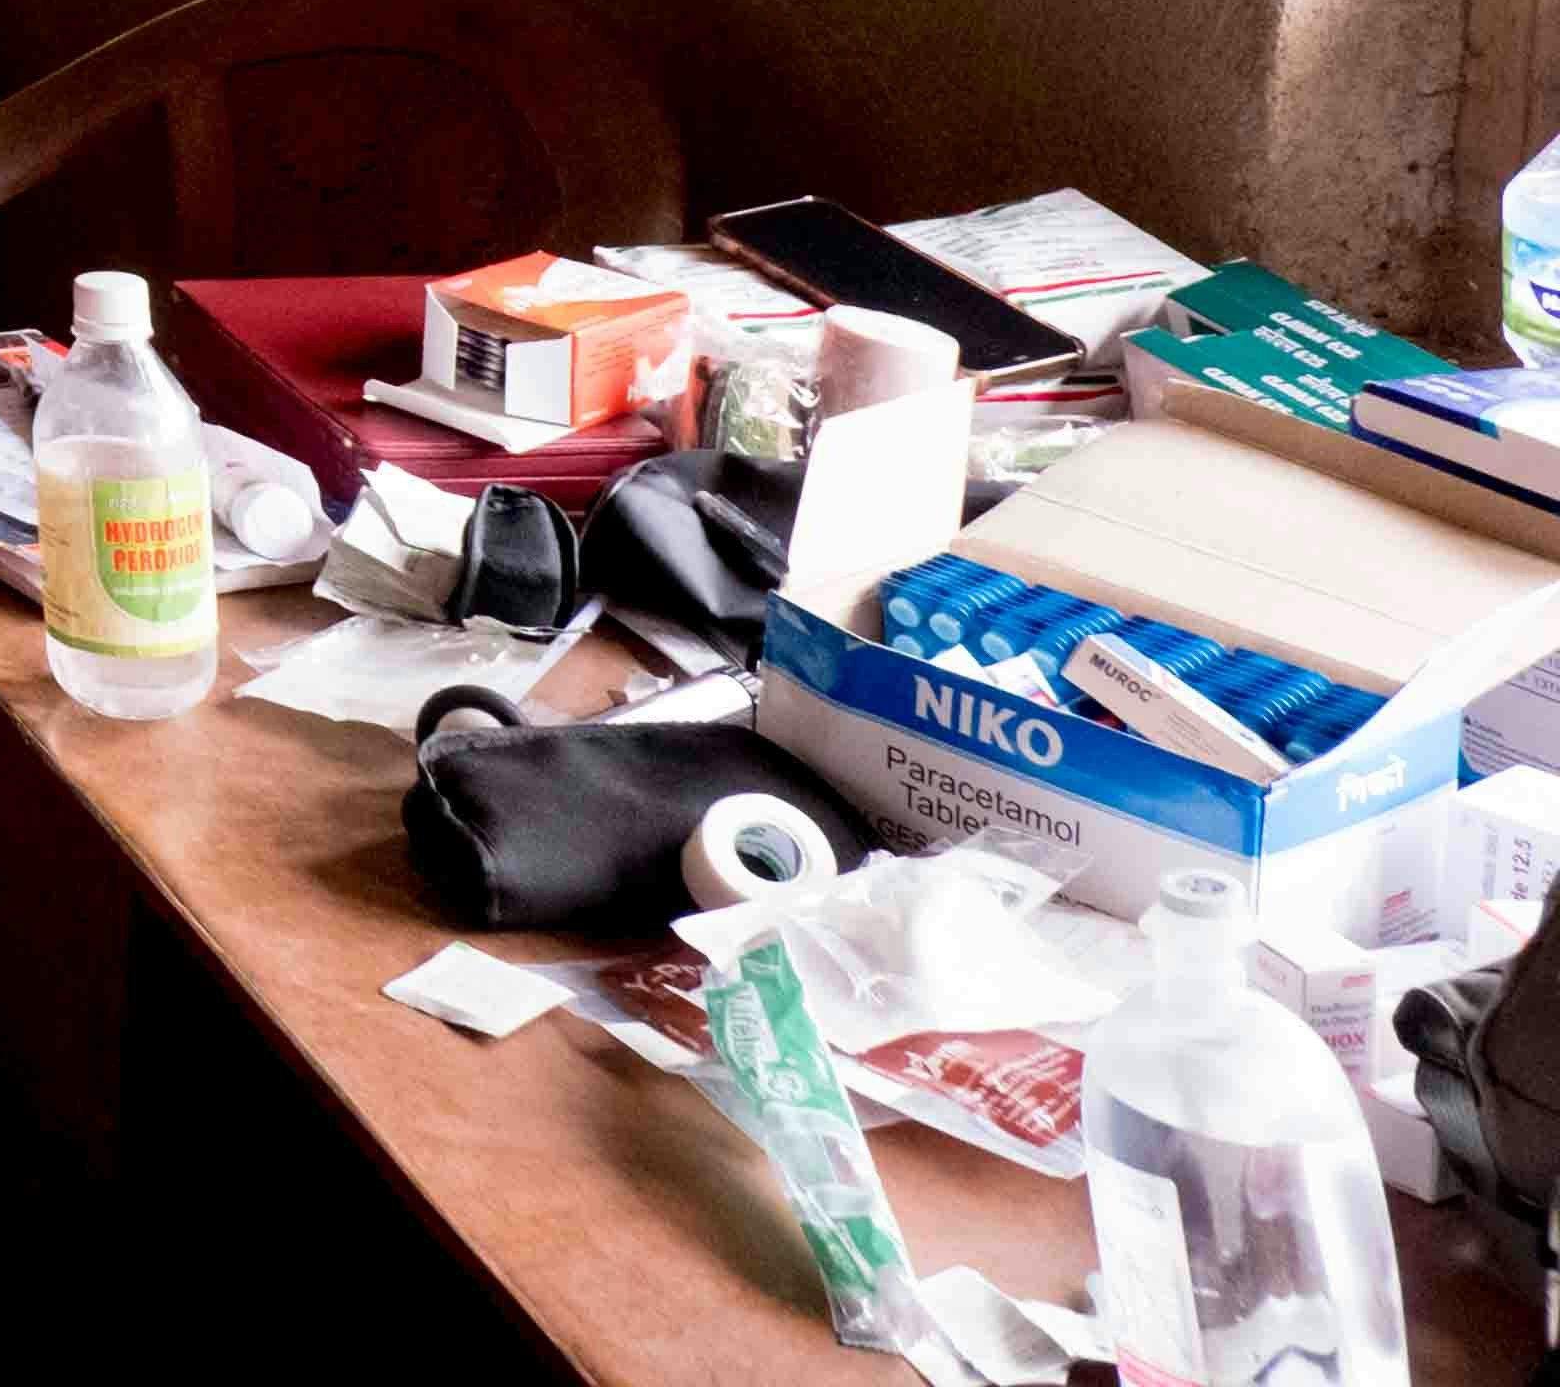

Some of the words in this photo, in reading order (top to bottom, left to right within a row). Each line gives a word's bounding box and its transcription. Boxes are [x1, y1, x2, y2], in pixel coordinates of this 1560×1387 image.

[913, 675, 1064, 767] NIKO
[1089, 653, 1153, 703] MUROC
[887, 745, 1082, 846] Paracetamol
